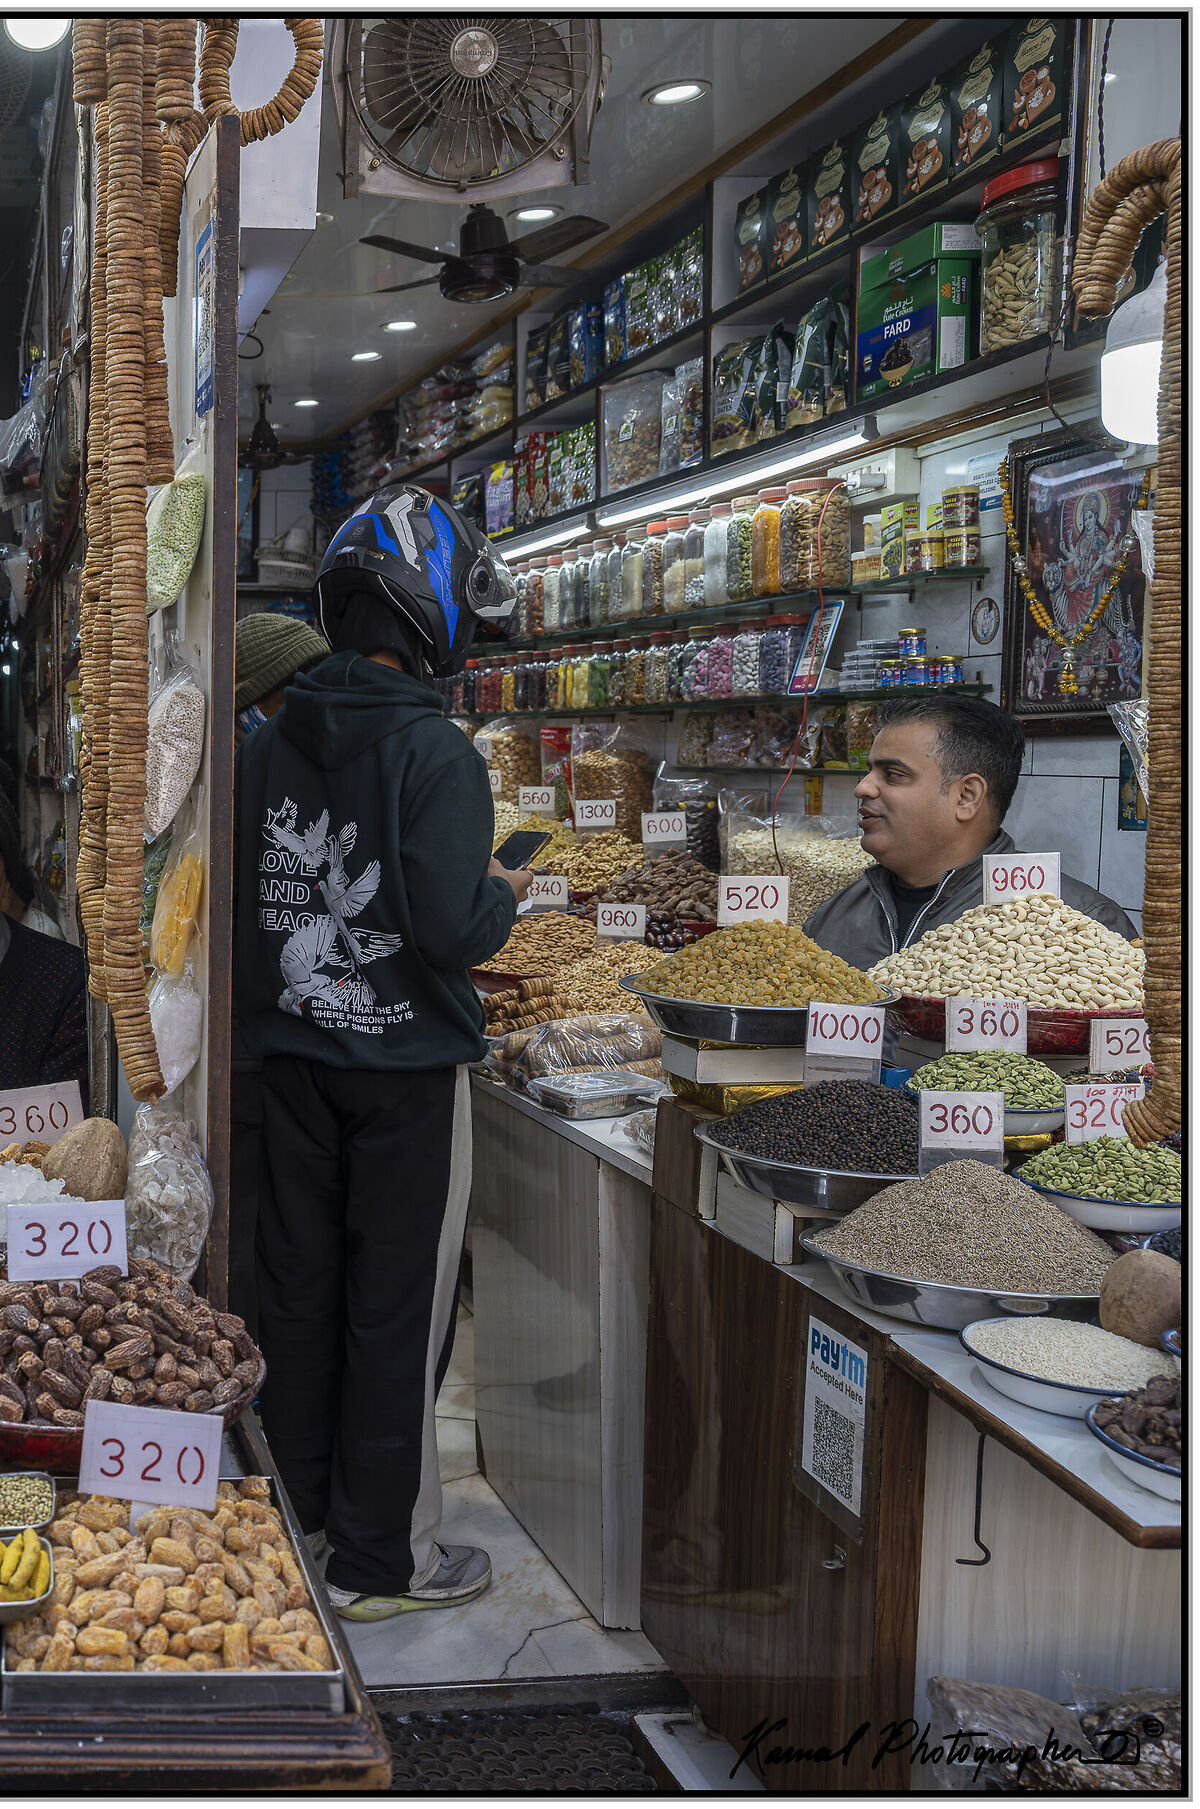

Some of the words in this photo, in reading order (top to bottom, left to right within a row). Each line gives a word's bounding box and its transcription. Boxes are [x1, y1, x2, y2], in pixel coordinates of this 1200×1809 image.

[884, 318, 911, 340] FARD
[522, 791, 551, 805] 560
[579, 803, 614, 820] 1300
[647, 817, 683, 835] 600
[529, 880, 562, 897] 840
[992, 865, 1045, 892] 960
[259, 878, 310, 904] AND
[726, 884, 779, 912] 520
[601, 909, 638, 928] 960
[311, 1009, 345, 1020] WHERE
[346, 1013, 385, 1025] PIGEONS
[387, 1013, 402, 1024] FLY
[404, 1010, 414, 1020] IS
[351, 1005, 374, 1014] THAT
[375, 1006, 391, 1014] THE
[393, 1001, 410, 1013] SKY
[336, 1020, 349, 1028] OF
[351, 1023, 384, 1034] SMILES
[810, 1010, 881, 1044] 1000
[957, 1007, 1019, 1037] 360
[1086, 1087, 1106, 1098] 100
[930, 1103, 993, 1135] 360
[1070, 1098, 1129, 1129] 320
[25, 1220, 113, 1257] 320
[809, 1360, 844, 1393] Accepted
[844, 1383, 864, 1405] Here
[100, 1437, 205, 1485] 320
